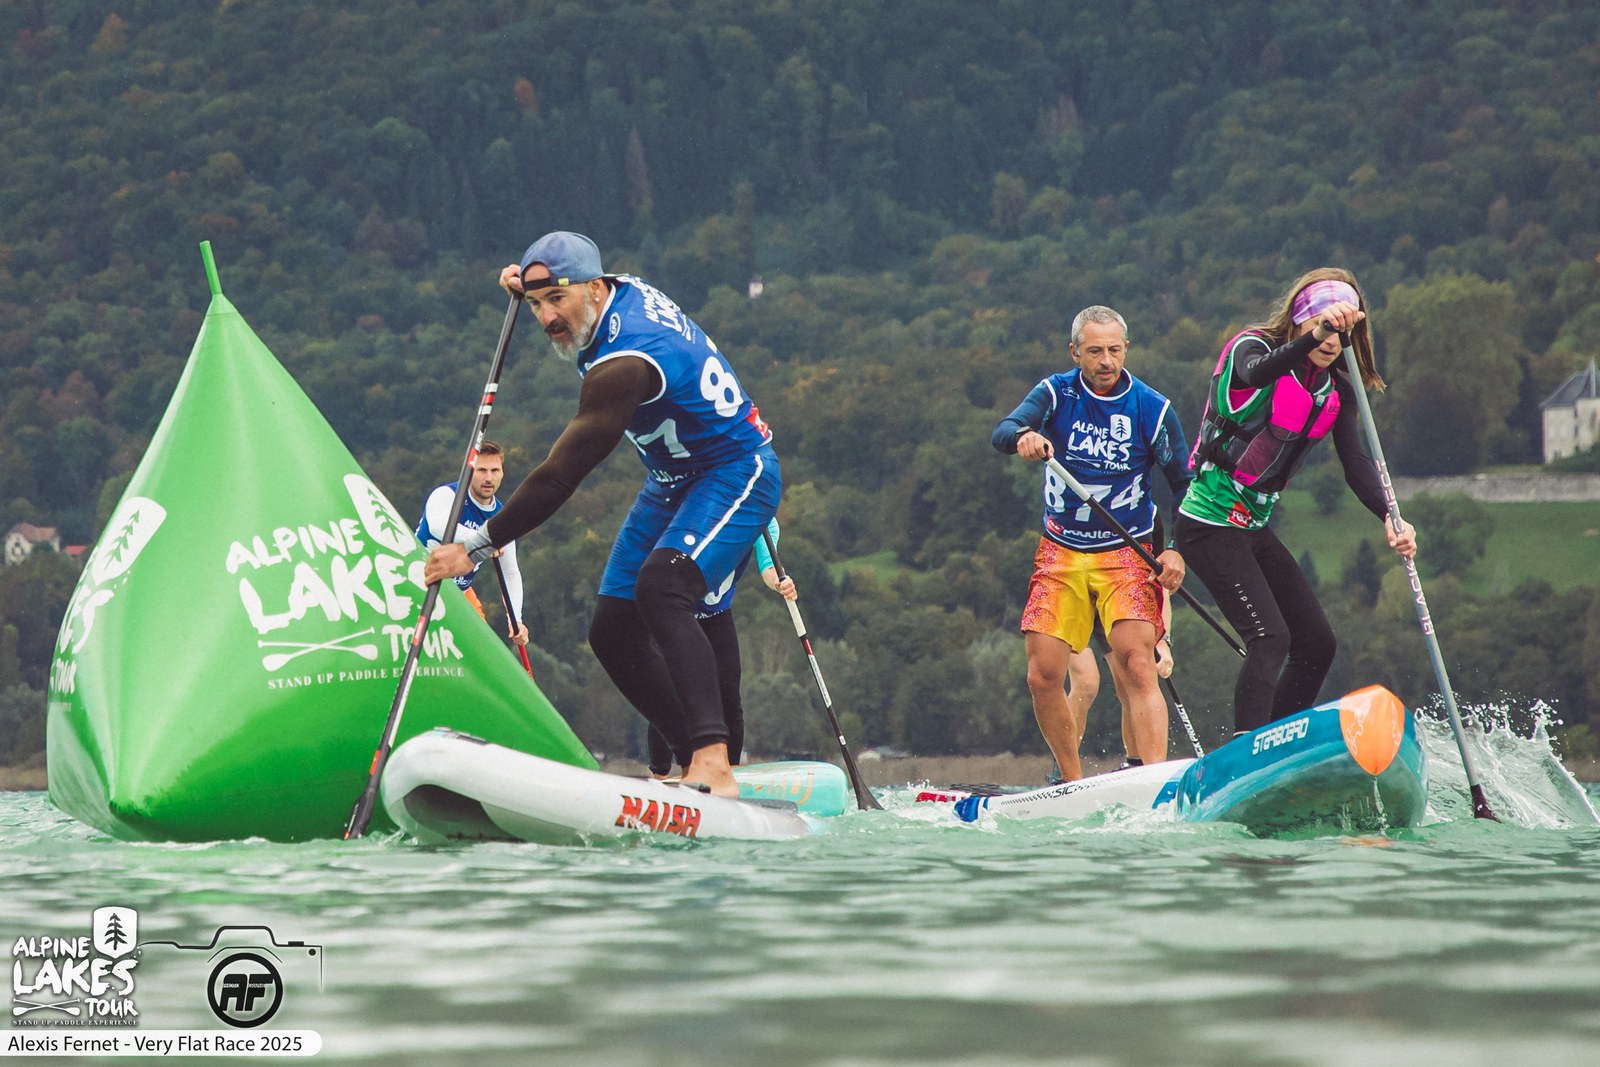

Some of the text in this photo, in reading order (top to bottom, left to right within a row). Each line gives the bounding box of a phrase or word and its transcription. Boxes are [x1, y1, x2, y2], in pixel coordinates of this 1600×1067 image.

[1067, 431, 1133, 462] LAKES
[1103, 459, 1132, 471] TOUR
[226, 518, 365, 575] ALPINE
[239, 553, 446, 635] LAKES
[268, 666, 465, 690] STAND UP PADDLE EERIENCE
[1252, 717, 1310, 756] STARBOARD
[613, 794, 702, 837] NAISH
